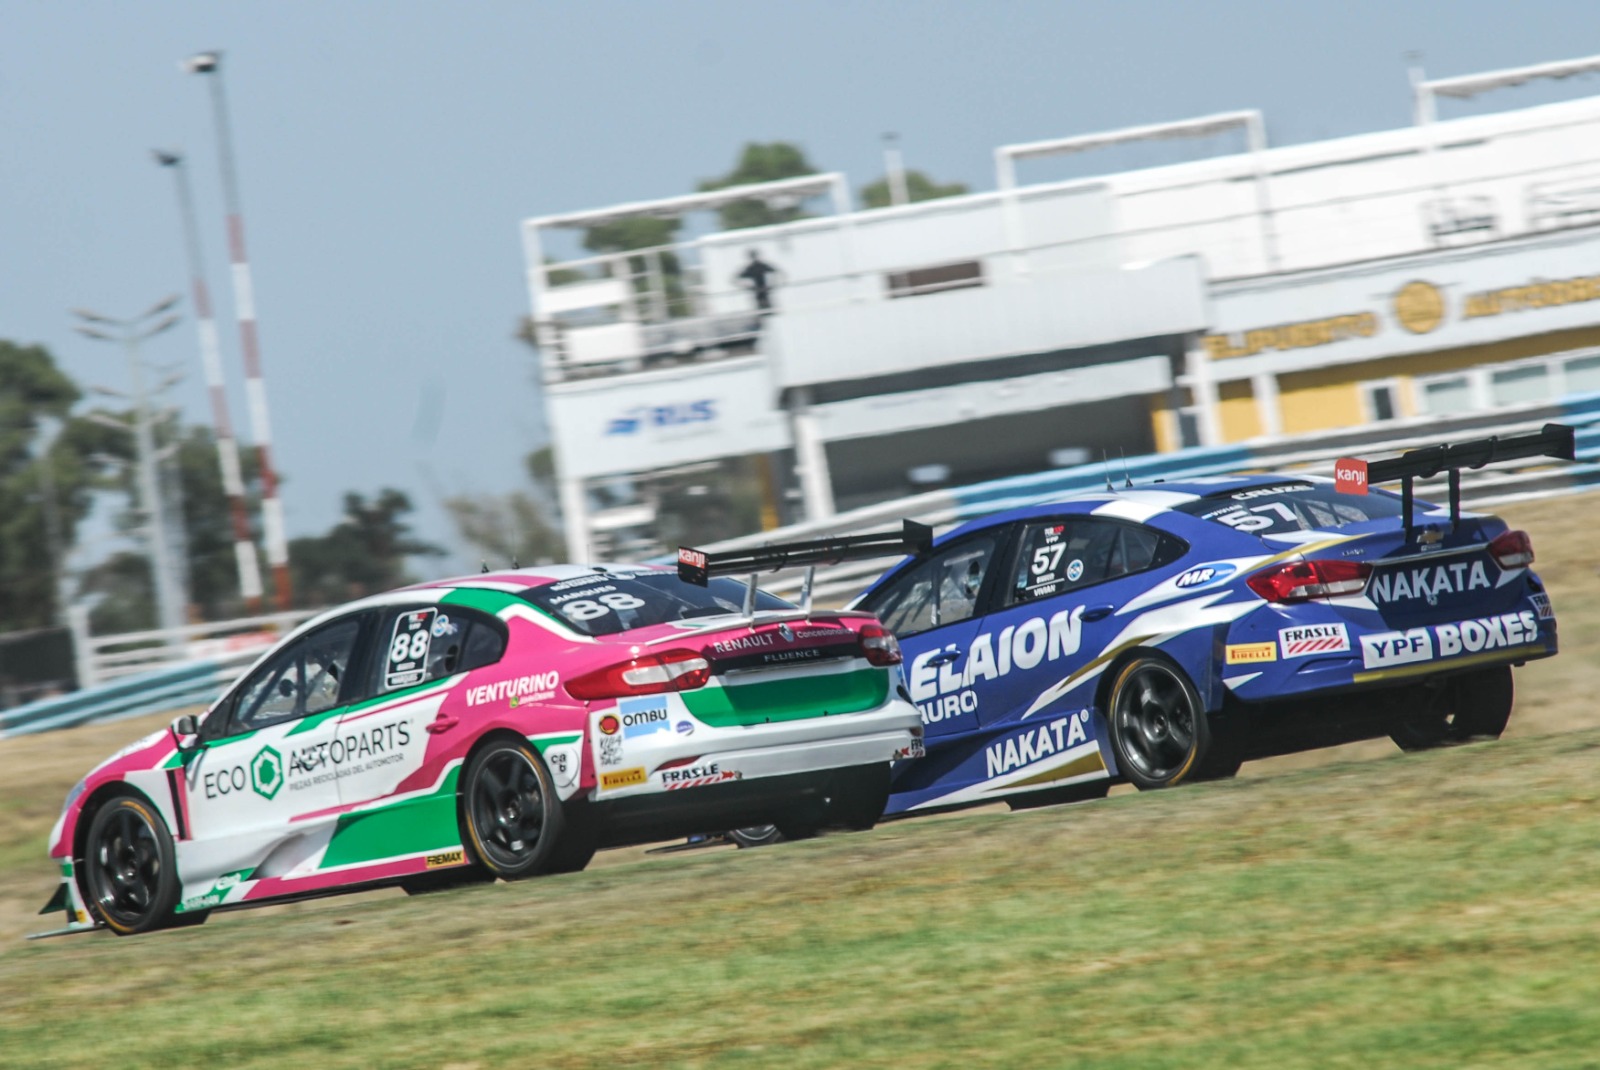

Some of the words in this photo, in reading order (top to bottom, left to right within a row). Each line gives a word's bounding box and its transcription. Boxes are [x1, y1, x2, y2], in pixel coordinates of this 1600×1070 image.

[1337, 468, 1366, 485] kanji
[1216, 502, 1298, 532] 57
[1031, 541, 1067, 576] 57
[1176, 568, 1215, 587] MR
[1372, 560, 1491, 604] NAKATA
[562, 592, 646, 621] 88
[391, 629, 429, 663] 88
[713, 633, 774, 653] RENAULT
[1370, 635, 1425, 660] YPF
[1434, 610, 1538, 658] BOXES
[763, 649, 821, 663] FLUENCE
[909, 604, 1086, 702] ELAION
[1231, 646, 1271, 660] PIRELLI
[466, 670, 559, 707] VENTURINO
[204, 764, 247, 799] ECO
[427, 852, 462, 866] FREMAX
